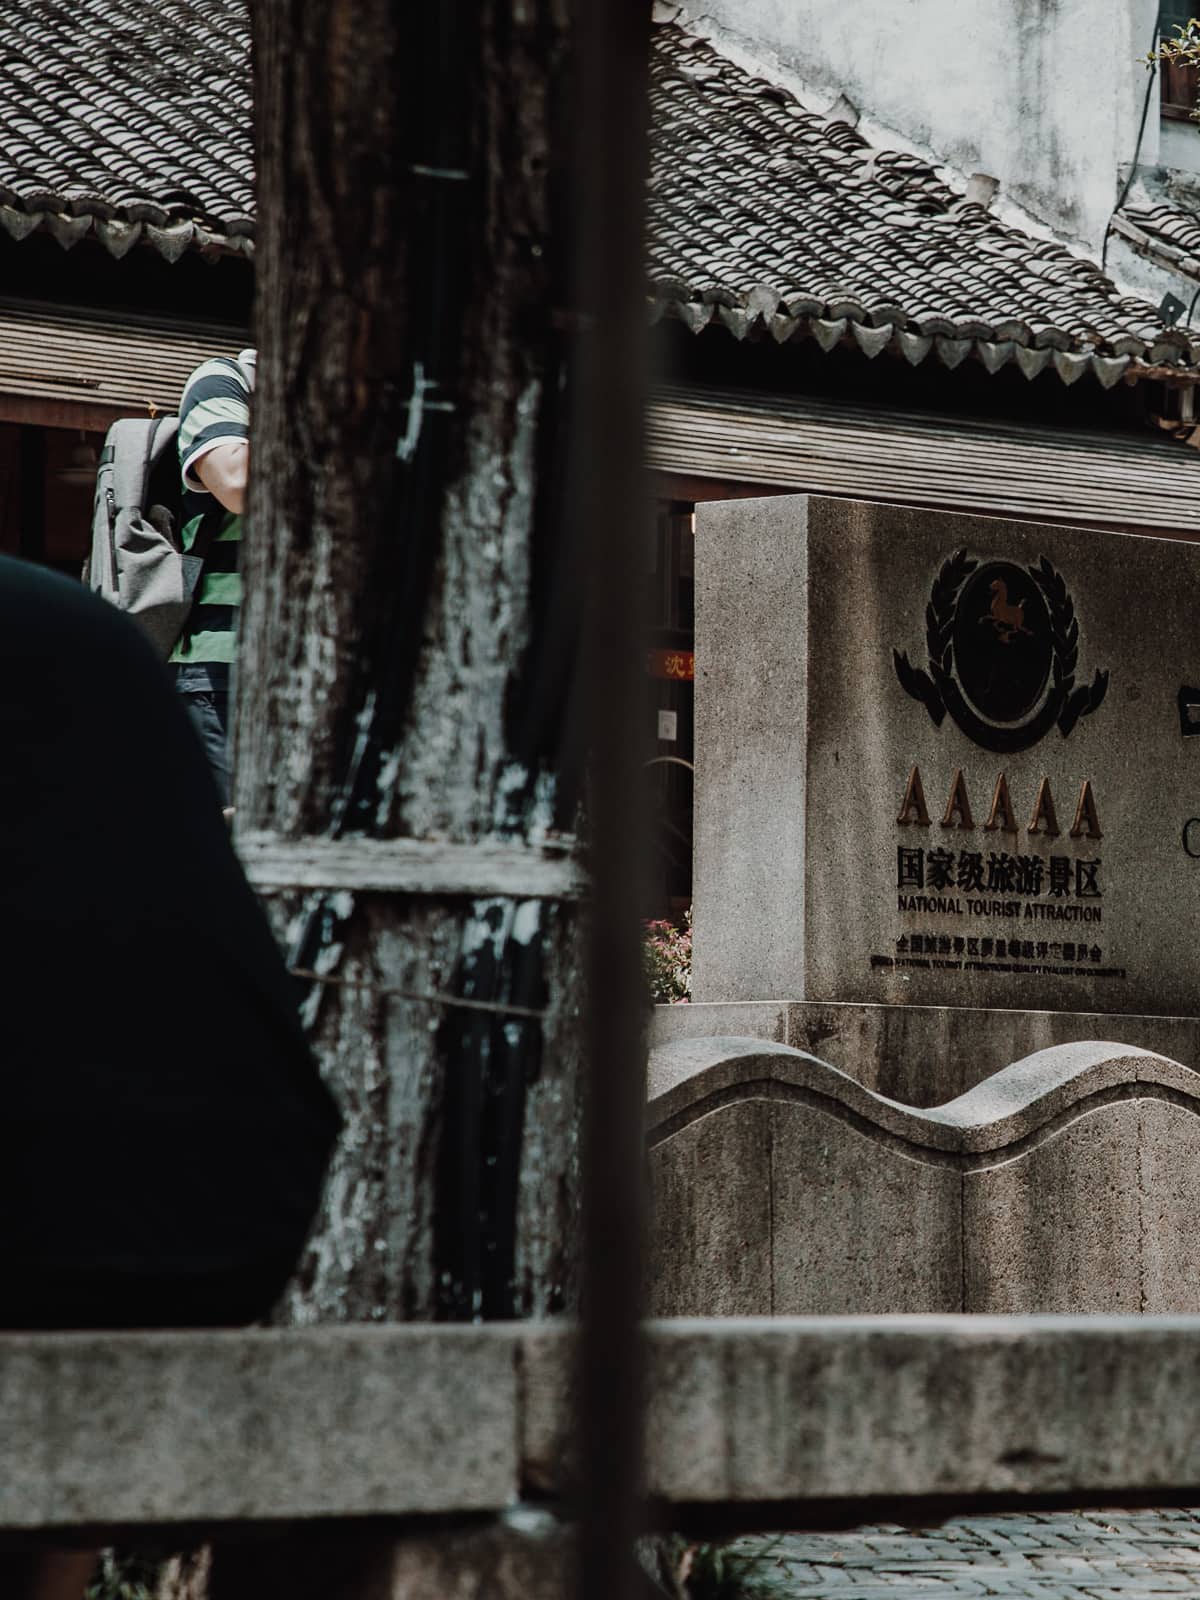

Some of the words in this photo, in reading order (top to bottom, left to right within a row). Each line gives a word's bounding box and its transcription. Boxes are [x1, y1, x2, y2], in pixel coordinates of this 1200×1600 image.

[897, 846, 1102, 898] 国家级旅游景区
[898, 895, 963, 915] NATIONAL
[966, 899, 1021, 918] TOURIST
[1024, 903, 1102, 922] ATTRACTION
